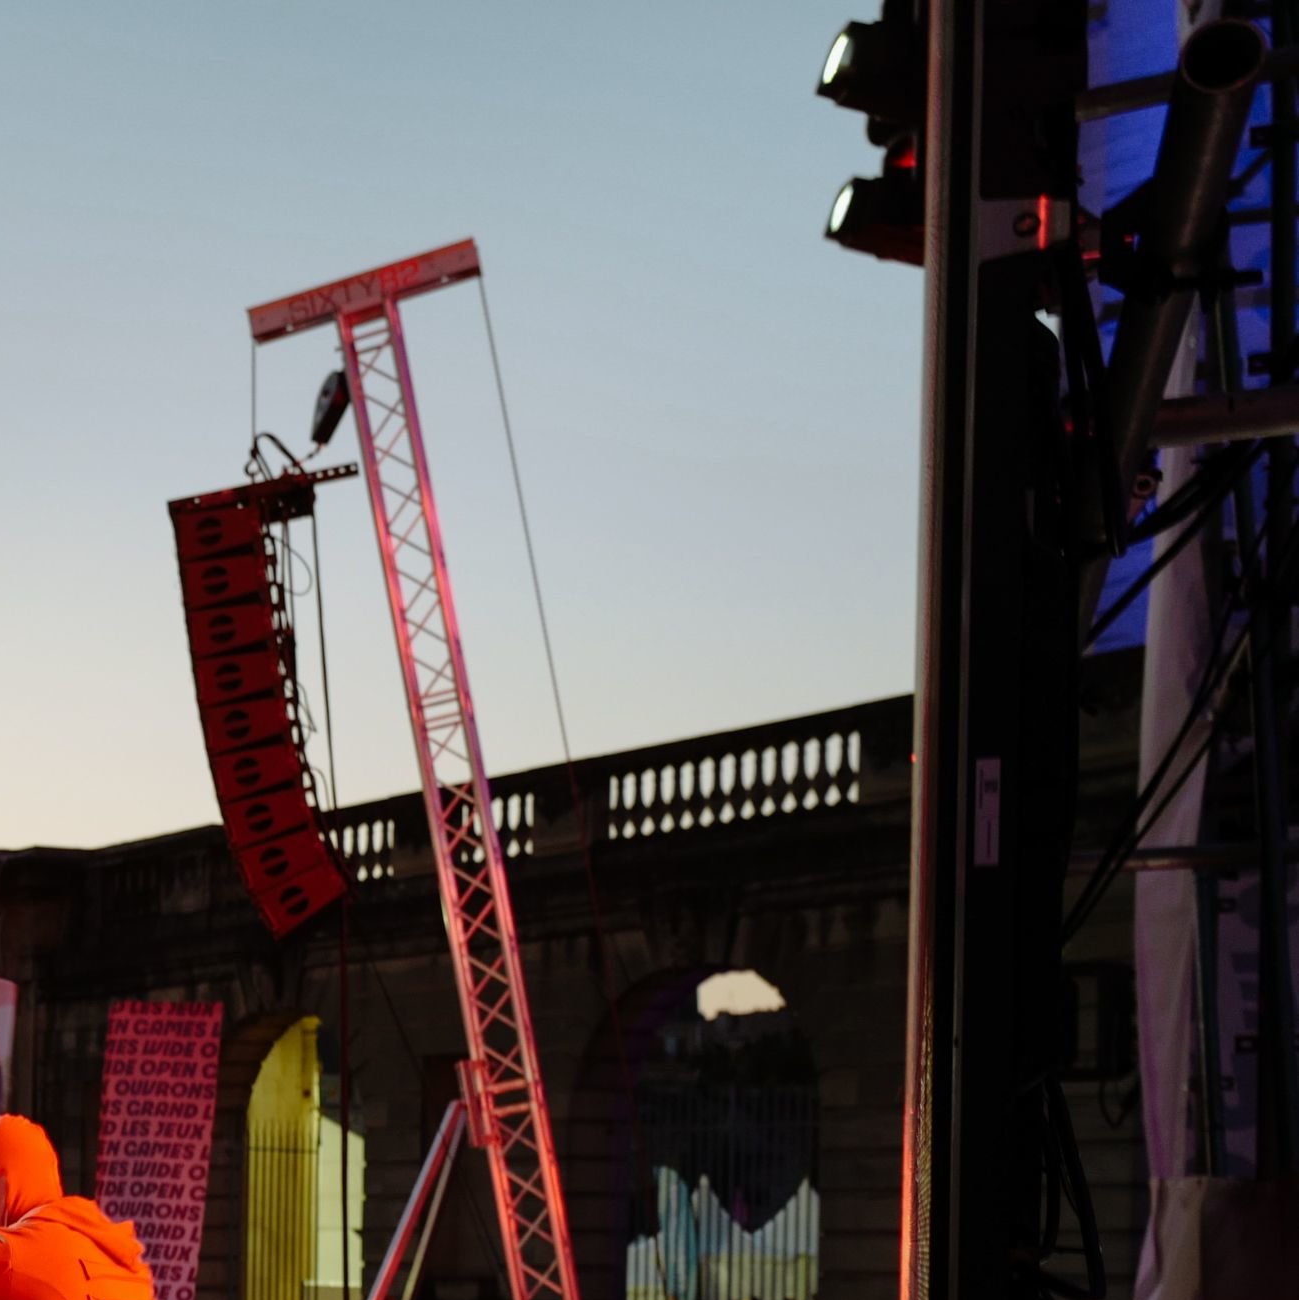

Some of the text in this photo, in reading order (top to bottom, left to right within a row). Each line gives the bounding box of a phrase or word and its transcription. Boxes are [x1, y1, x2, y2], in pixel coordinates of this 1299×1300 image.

[133, 1019, 206, 1037] GAMES
[143, 1040, 197, 1056] WIDE
[201, 1042, 217, 1058] O
[140, 1060, 197, 1078] OPEN
[115, 1079, 215, 1099] OUVRONS
[127, 1100, 198, 1118] GRAND
[121, 1120, 151, 1137] LES
[155, 1122, 205, 1140] JEUX
[124, 1140, 195, 1159] GAMES
[132, 1161, 184, 1179] WIDE
[189, 1165, 206, 1181] O
[129, 1181, 185, 1200] OPEN
[104, 1201, 201, 1222] OUVRONS
